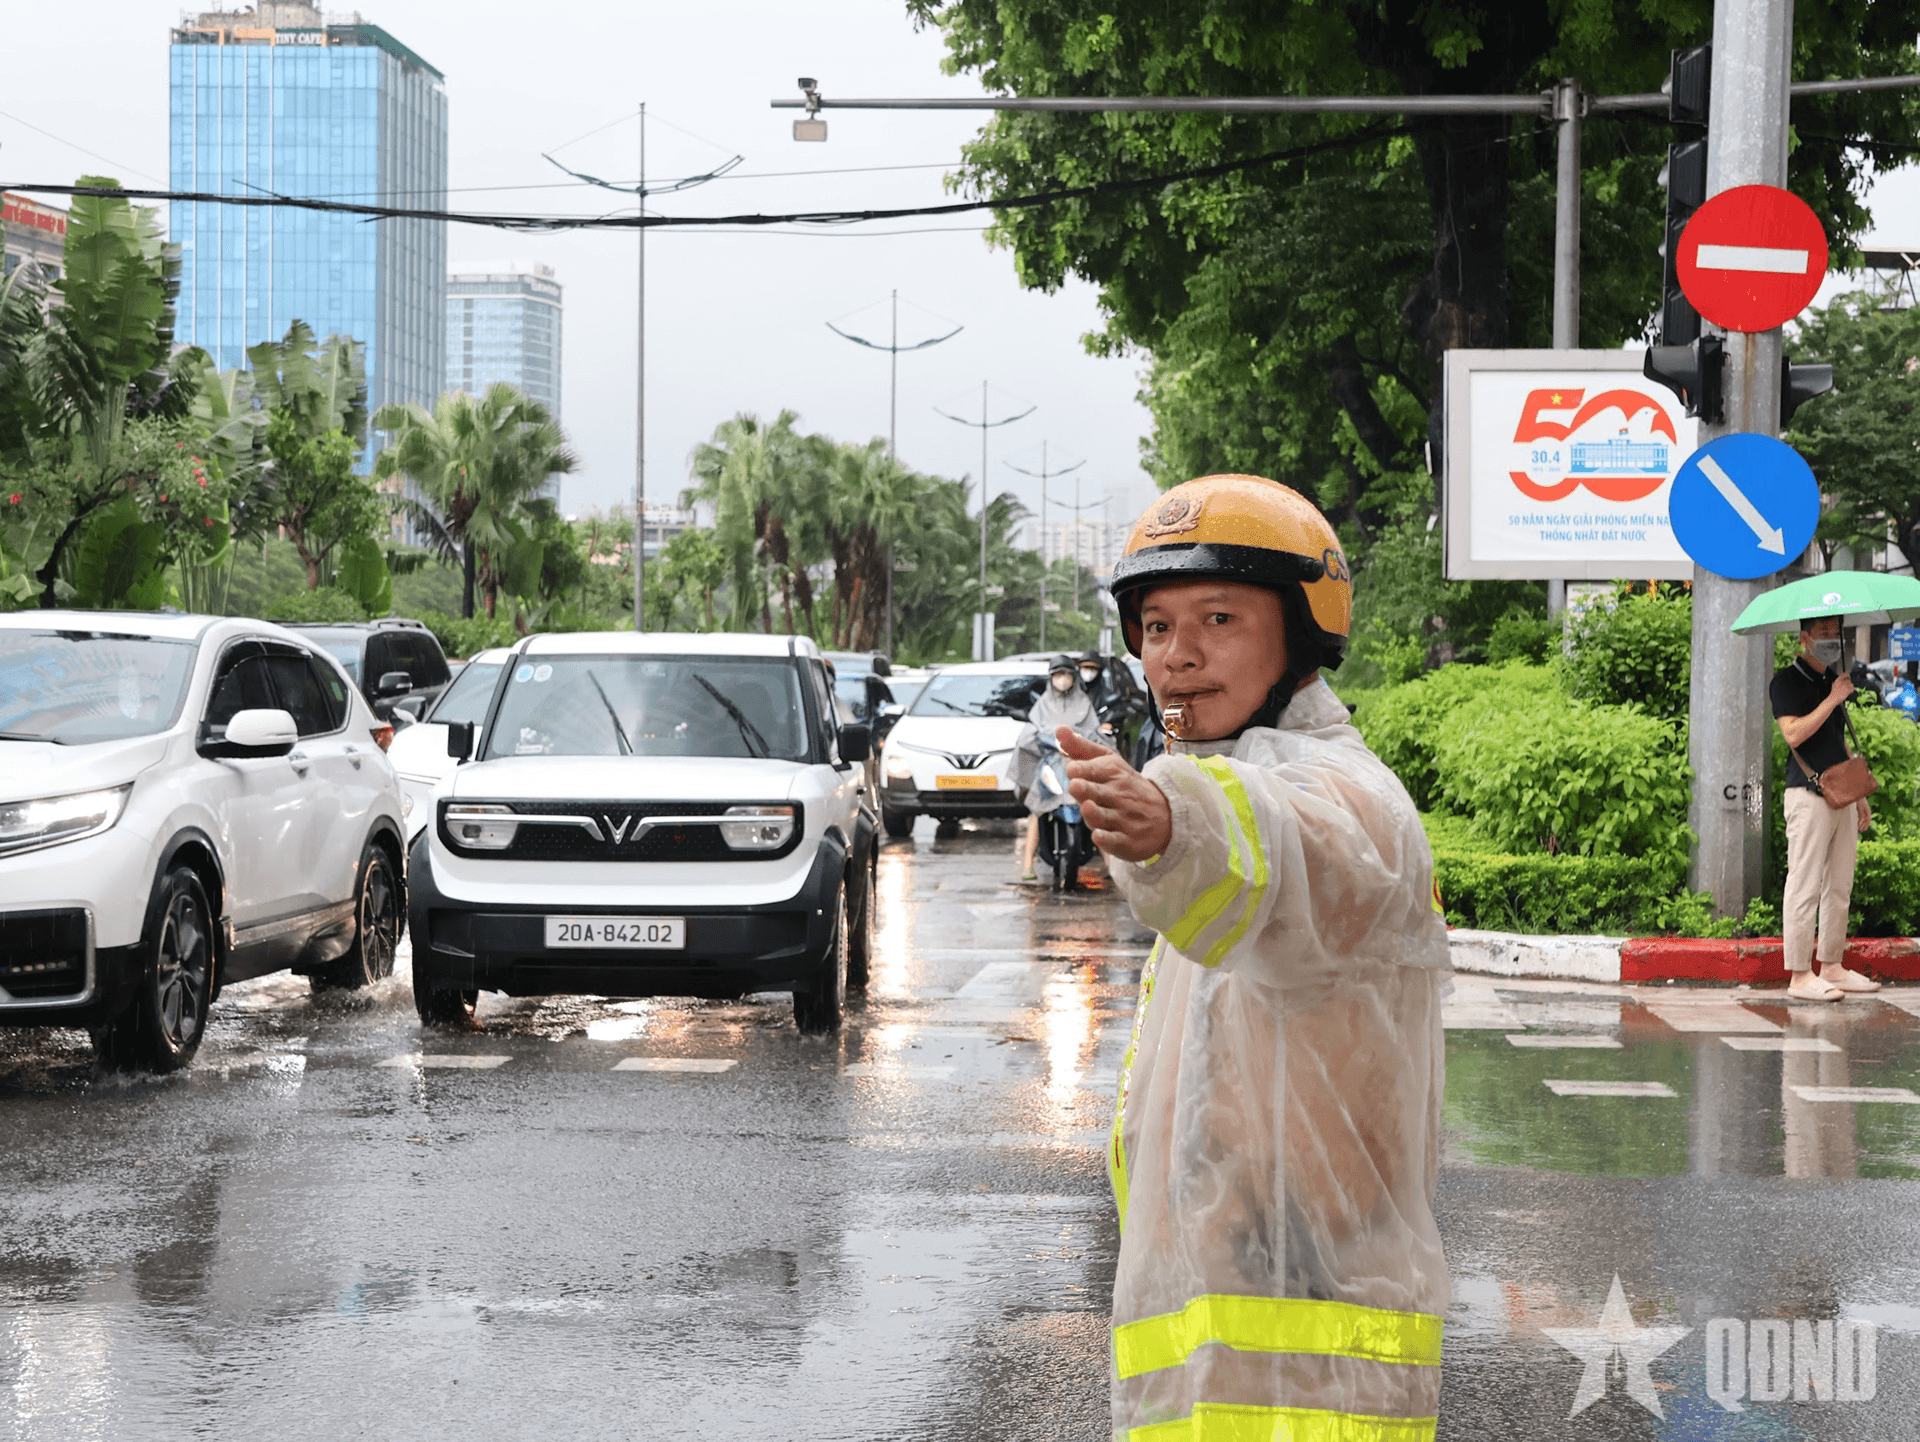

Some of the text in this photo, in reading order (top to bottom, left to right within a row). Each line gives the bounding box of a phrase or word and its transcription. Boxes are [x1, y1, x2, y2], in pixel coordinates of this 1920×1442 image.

[1531, 450, 1561, 463] 30.4
[1509, 515, 1520, 526] 50
[1546, 513, 1571, 526] NGÀY
[1595, 513, 1627, 526] PHÓNG
[1656, 515, 1669, 526] NA
[558, 924, 672, 942] 20A-842.02
